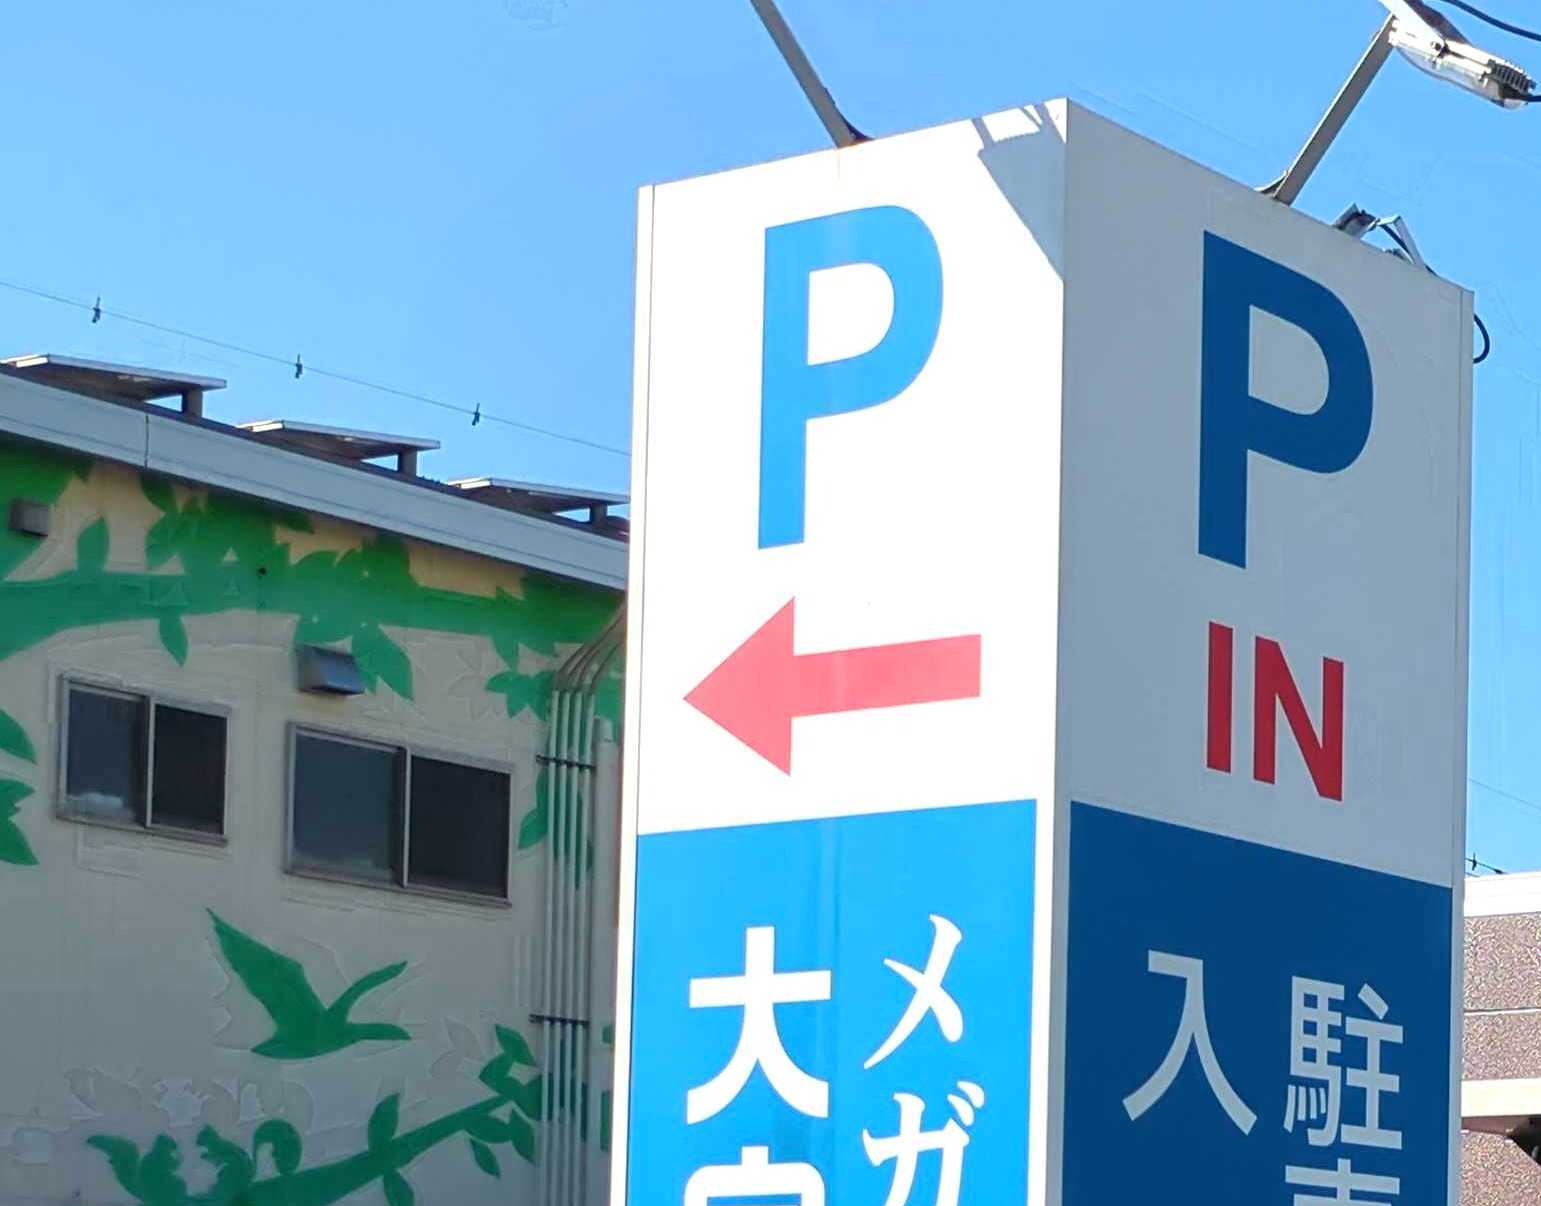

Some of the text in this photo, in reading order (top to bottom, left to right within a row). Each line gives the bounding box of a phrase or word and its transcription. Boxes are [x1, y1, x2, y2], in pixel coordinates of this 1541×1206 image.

[758, 205, 944, 549] P
[1198, 229, 1374, 570] P
[1206, 620, 1345, 802] IN
